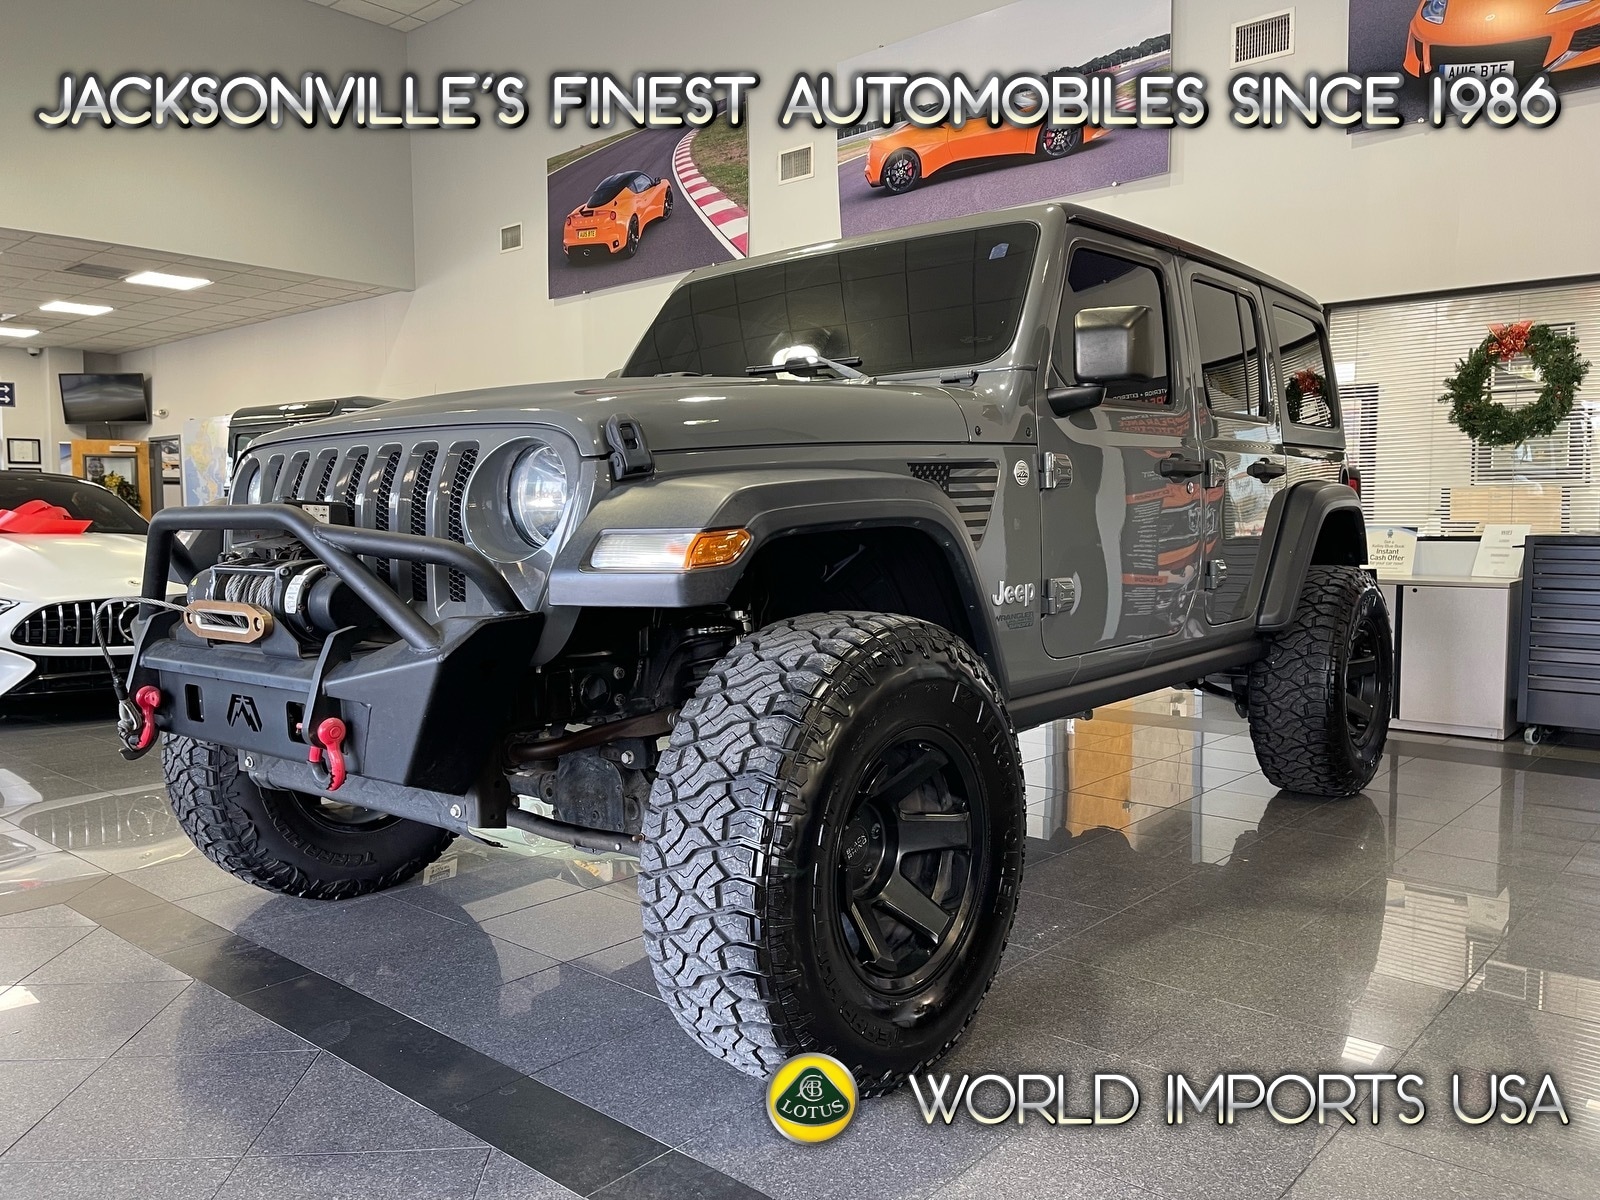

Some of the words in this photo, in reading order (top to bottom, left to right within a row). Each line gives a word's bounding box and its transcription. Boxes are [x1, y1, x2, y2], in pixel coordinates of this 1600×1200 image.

[1387, 554, 1405, 562] Offer
[991, 580, 1036, 608] Jeep
[994, 611, 1034, 622] WRANGLER
